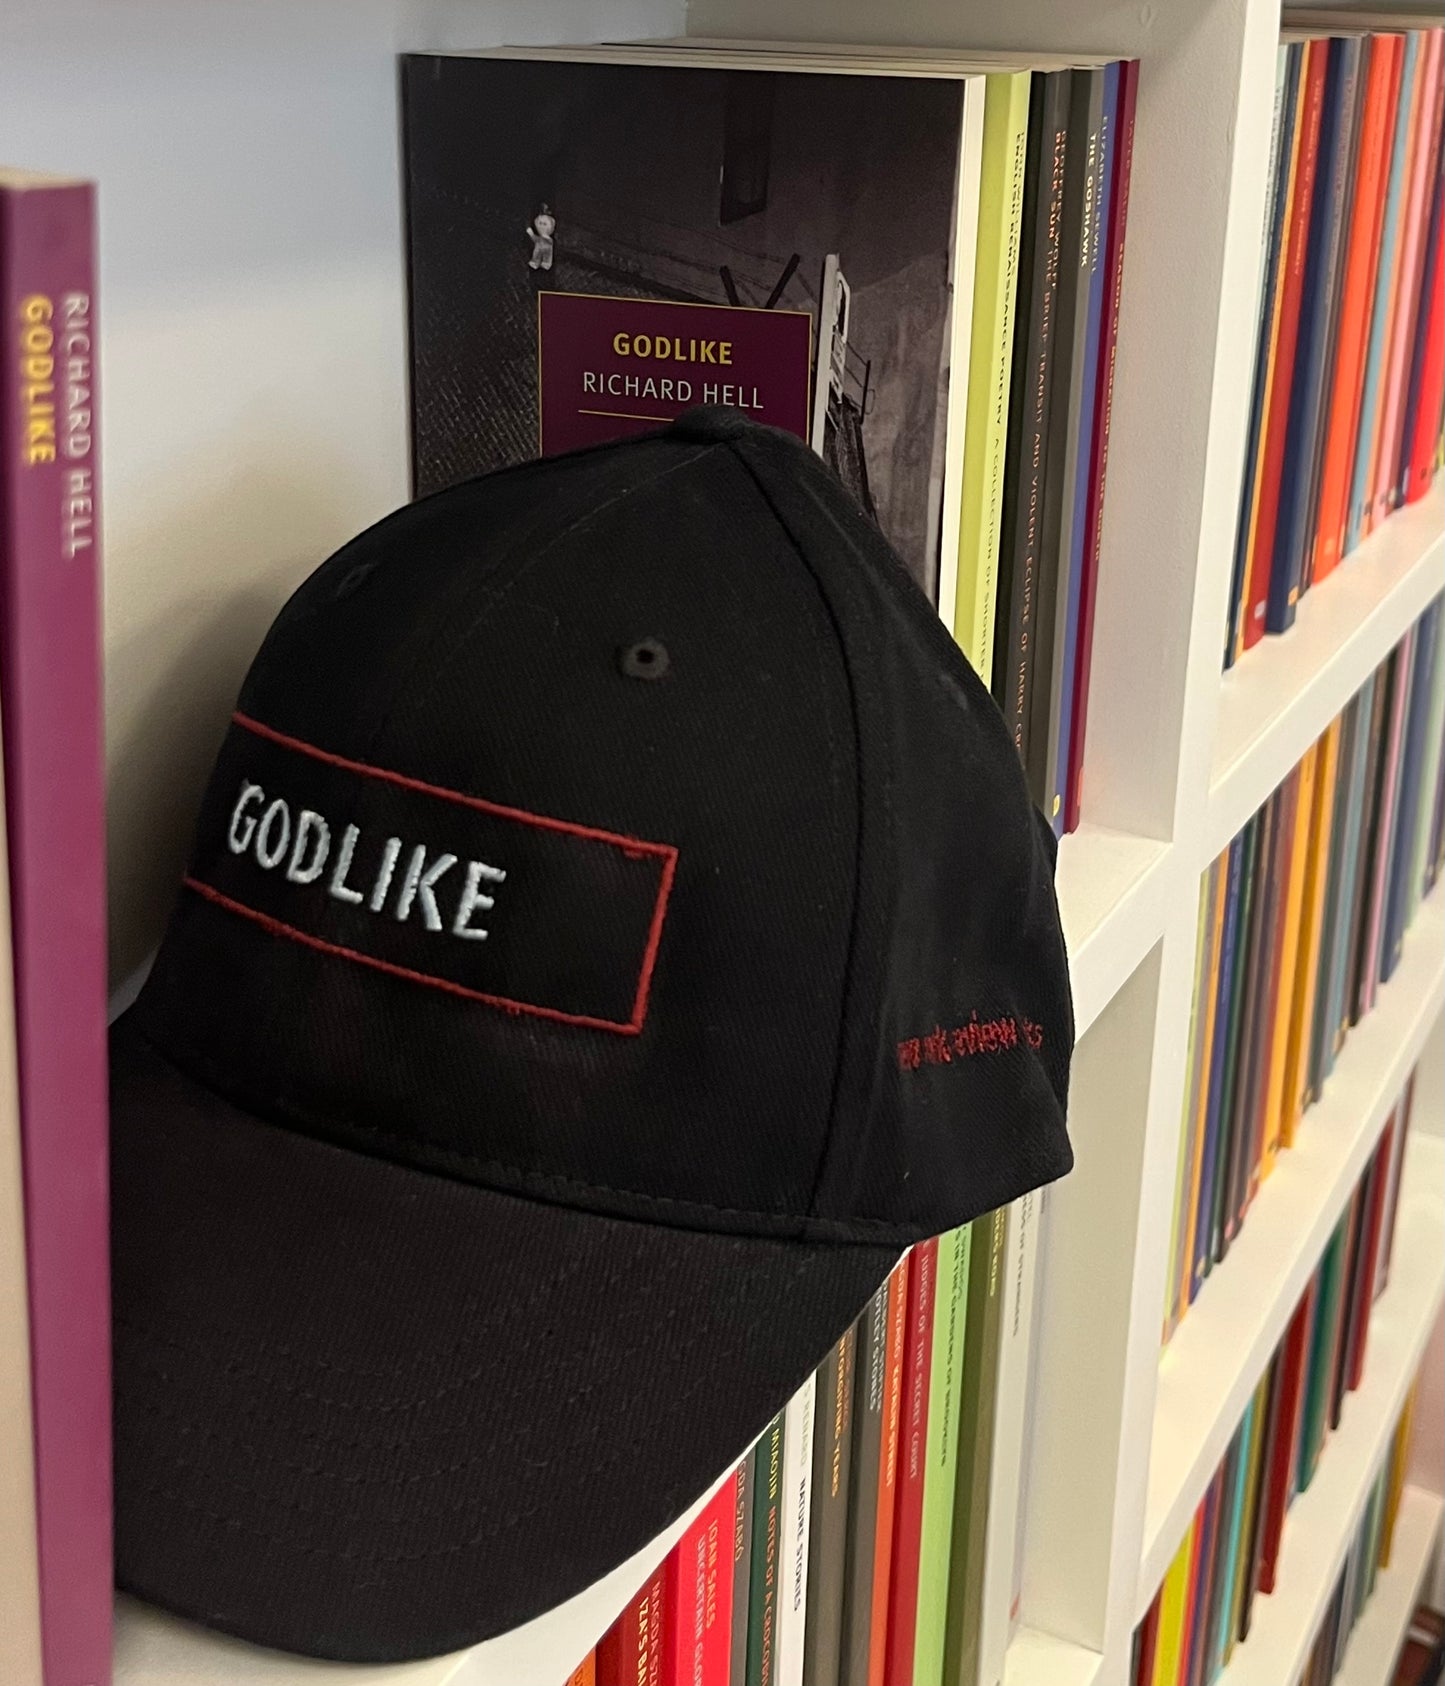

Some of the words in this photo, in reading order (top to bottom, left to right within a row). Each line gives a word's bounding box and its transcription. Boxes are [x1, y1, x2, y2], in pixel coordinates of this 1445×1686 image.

[1081, 176, 1093, 267] GOSHAWK
[23, 294, 56, 466] GODLIKE
[64, 291, 92, 460] RICHARD
[612, 331, 733, 366] GODLIKE
[582, 371, 693, 402] RICHARD
[703, 382, 765, 410] HELL
[62, 468, 94, 560] HELL
[1028, 475, 1038, 548] VIOLENT
[1021, 632, 1028, 652] OF
[1017, 661, 1026, 714] HARRY
[226, 778, 508, 942] GODLIKE
[770, 1427, 778, 1499] MIAOJIN
[798, 1478, 806, 1541] NATURE
[696, 1534, 706, 1638] UNCERTAIN
[707, 1569, 716, 1628] SALES
[765, 1565, 772, 1586] OF
[638, 1597, 649, 1651] IZA'S
[650, 1581, 660, 1654] MAGDA
